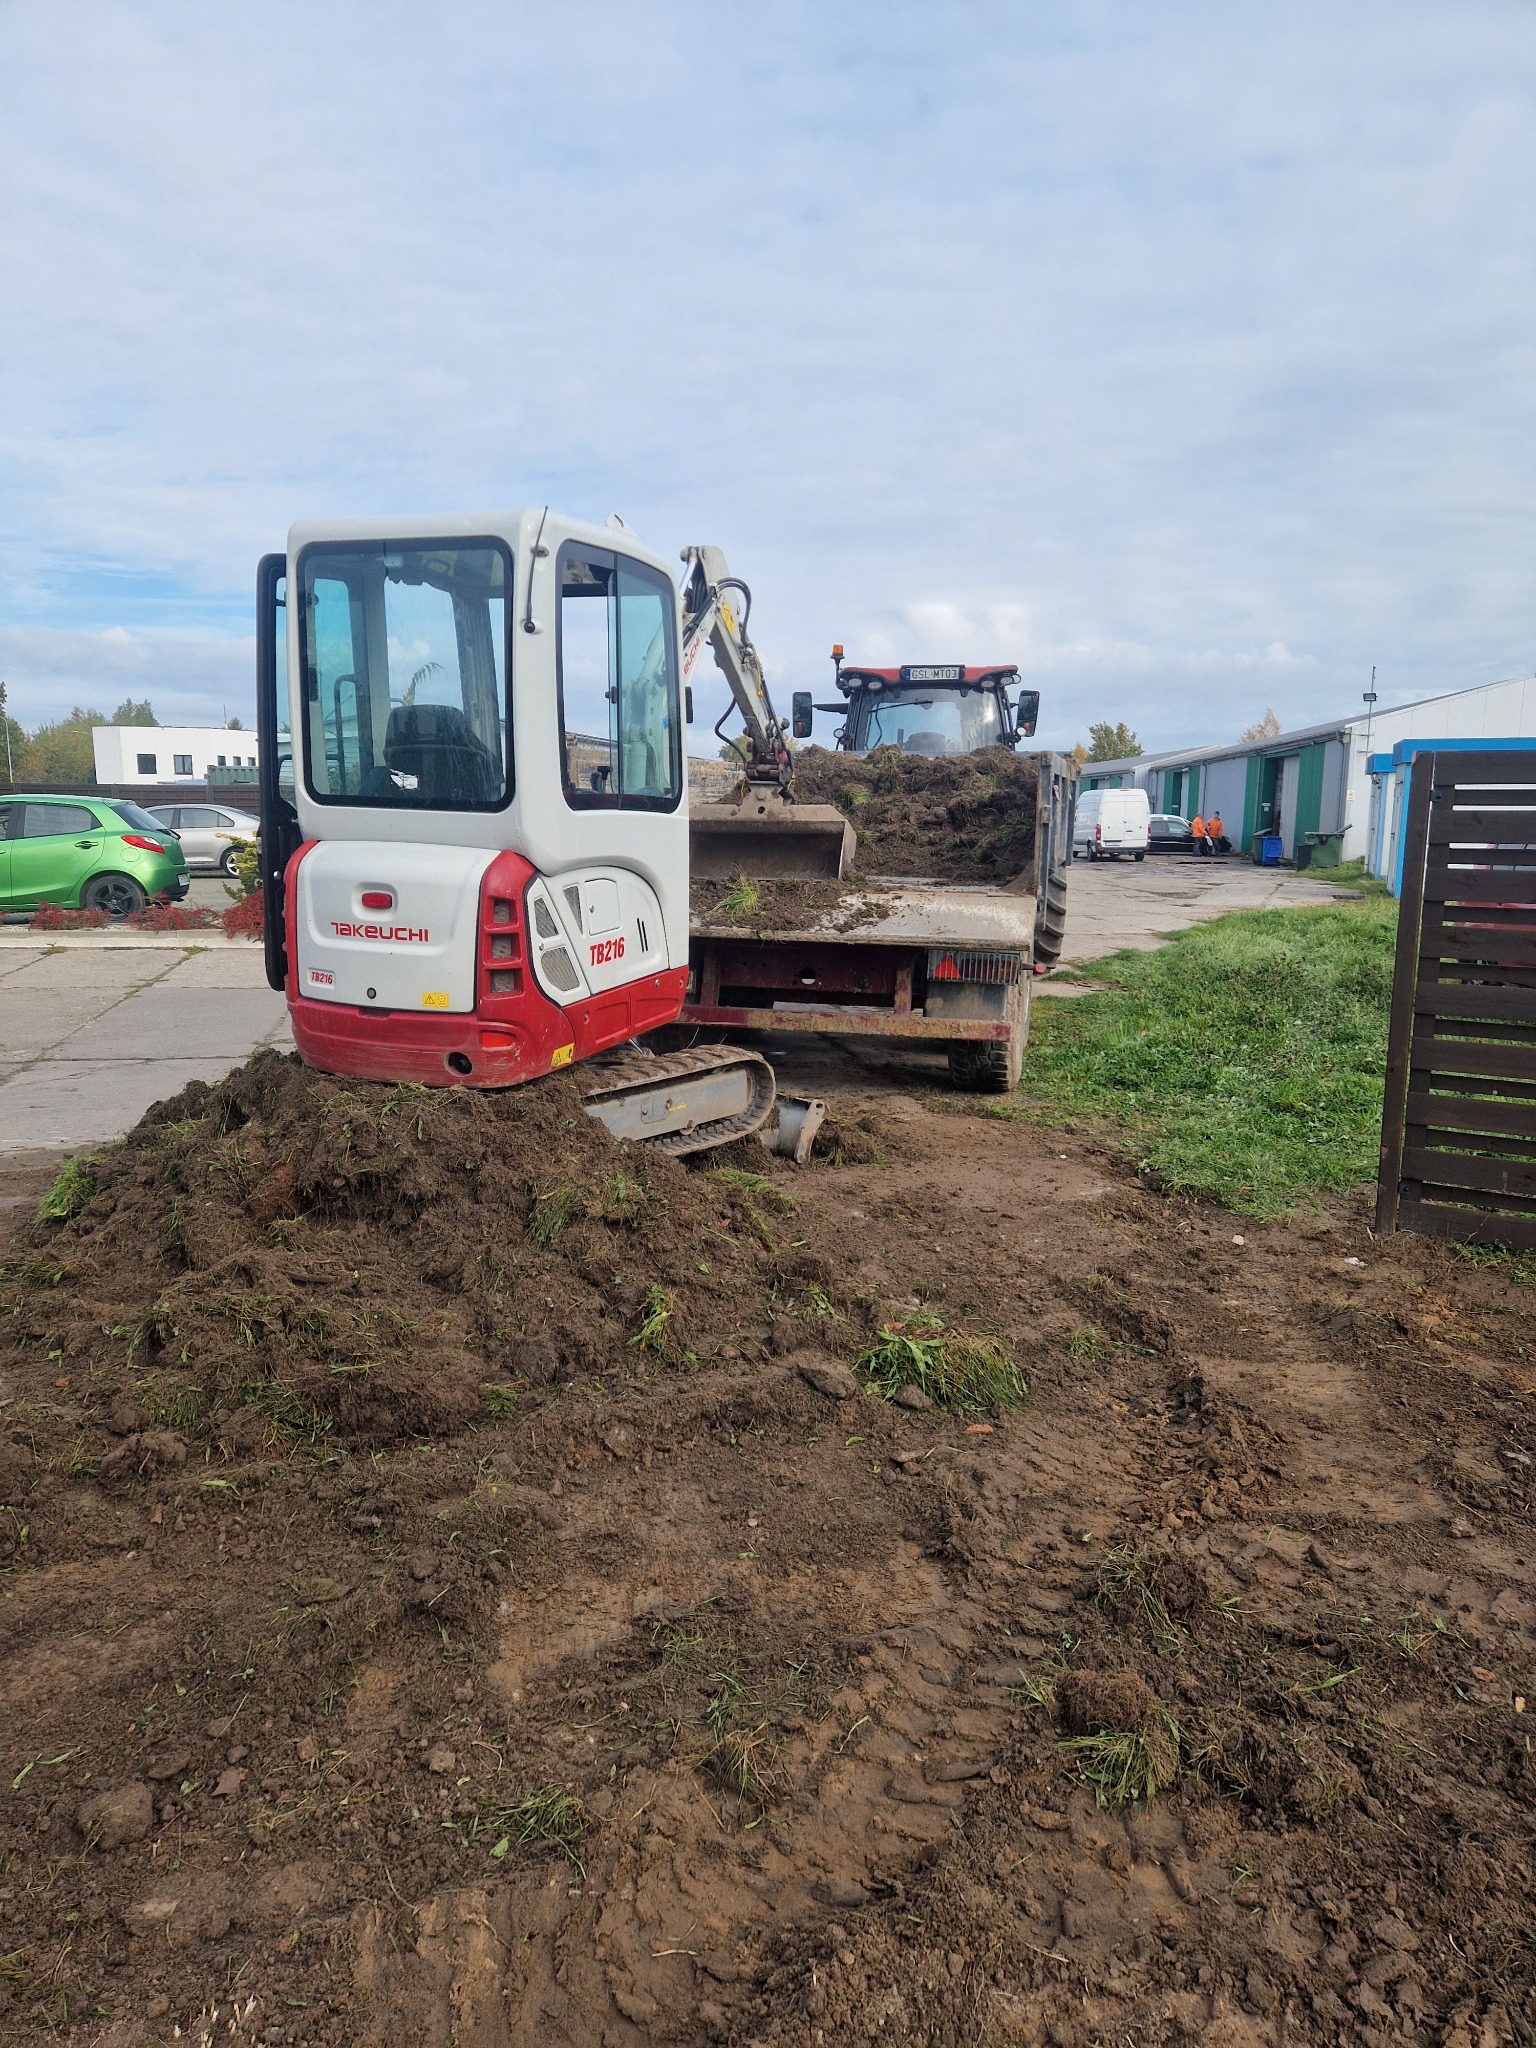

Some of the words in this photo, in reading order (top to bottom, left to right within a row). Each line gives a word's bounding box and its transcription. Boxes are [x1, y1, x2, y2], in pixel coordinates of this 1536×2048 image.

[683, 635, 700, 675] EUCHI
[911, 669, 930, 679] GSL
[330, 921, 429, 942] TAKEUCHI
[589, 936, 625, 967] TB216
[311, 971, 333, 985] TB216
